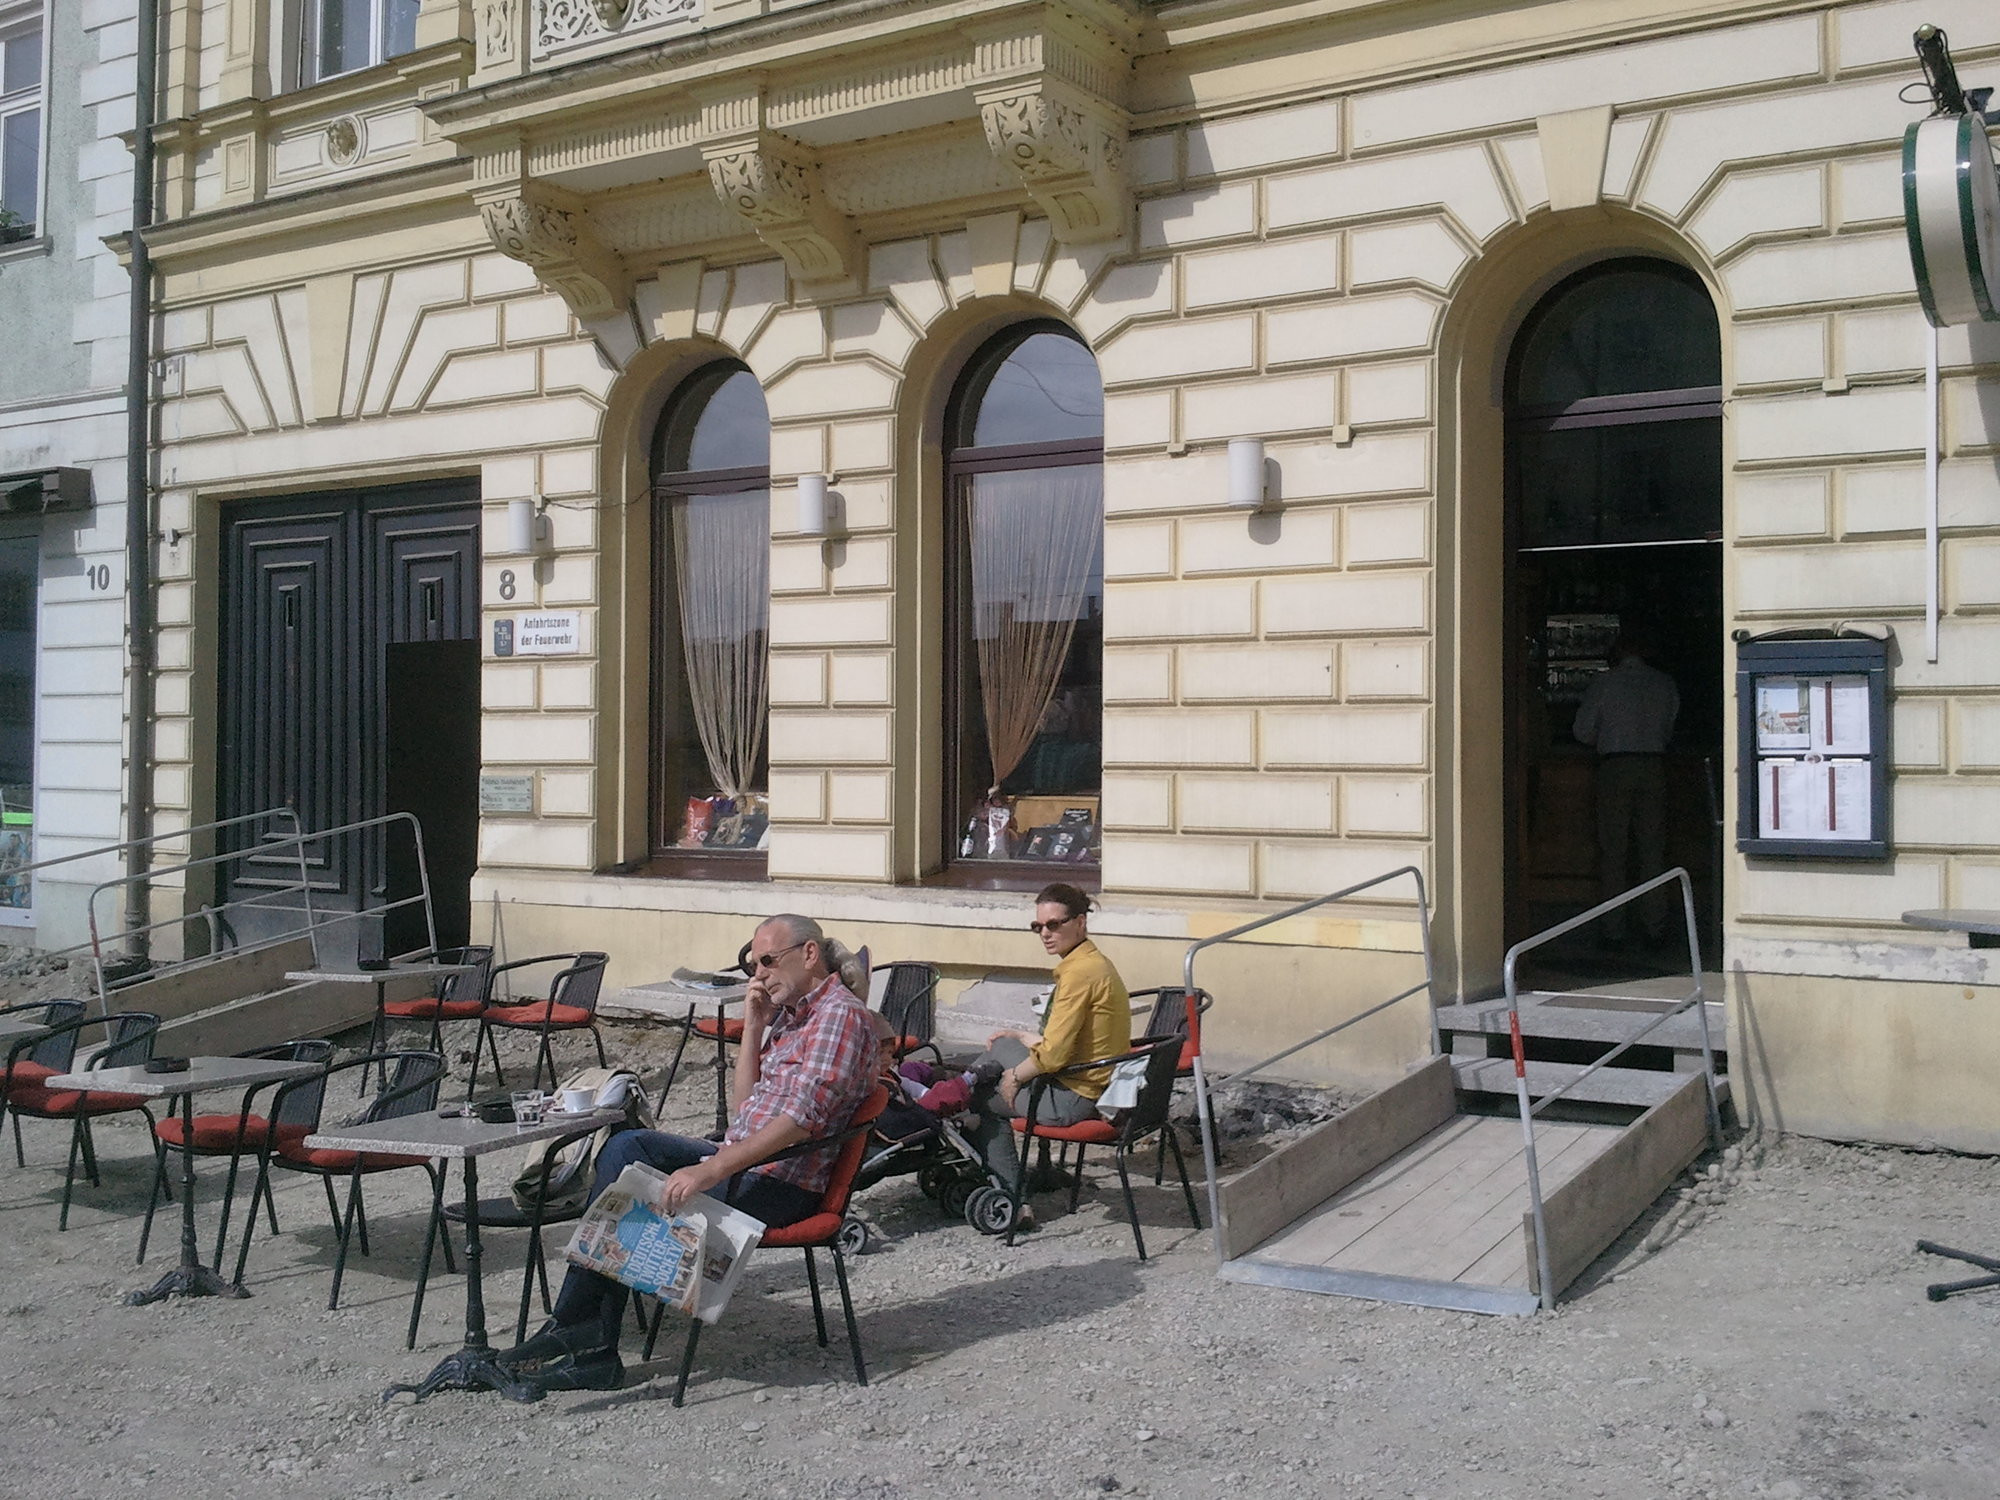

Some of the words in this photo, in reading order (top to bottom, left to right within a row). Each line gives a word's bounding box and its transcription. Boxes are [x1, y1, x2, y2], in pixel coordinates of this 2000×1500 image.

[87, 564, 110, 590] 10
[499, 569, 516, 600] 8
[524, 618, 570, 629] Anfahrtszone
[521, 635, 532, 646] der
[534, 633, 572, 646] Feuerwehr
[627, 1219, 662, 1274] DEUTSCHE
[652, 1239, 683, 1286] SOCIETY
